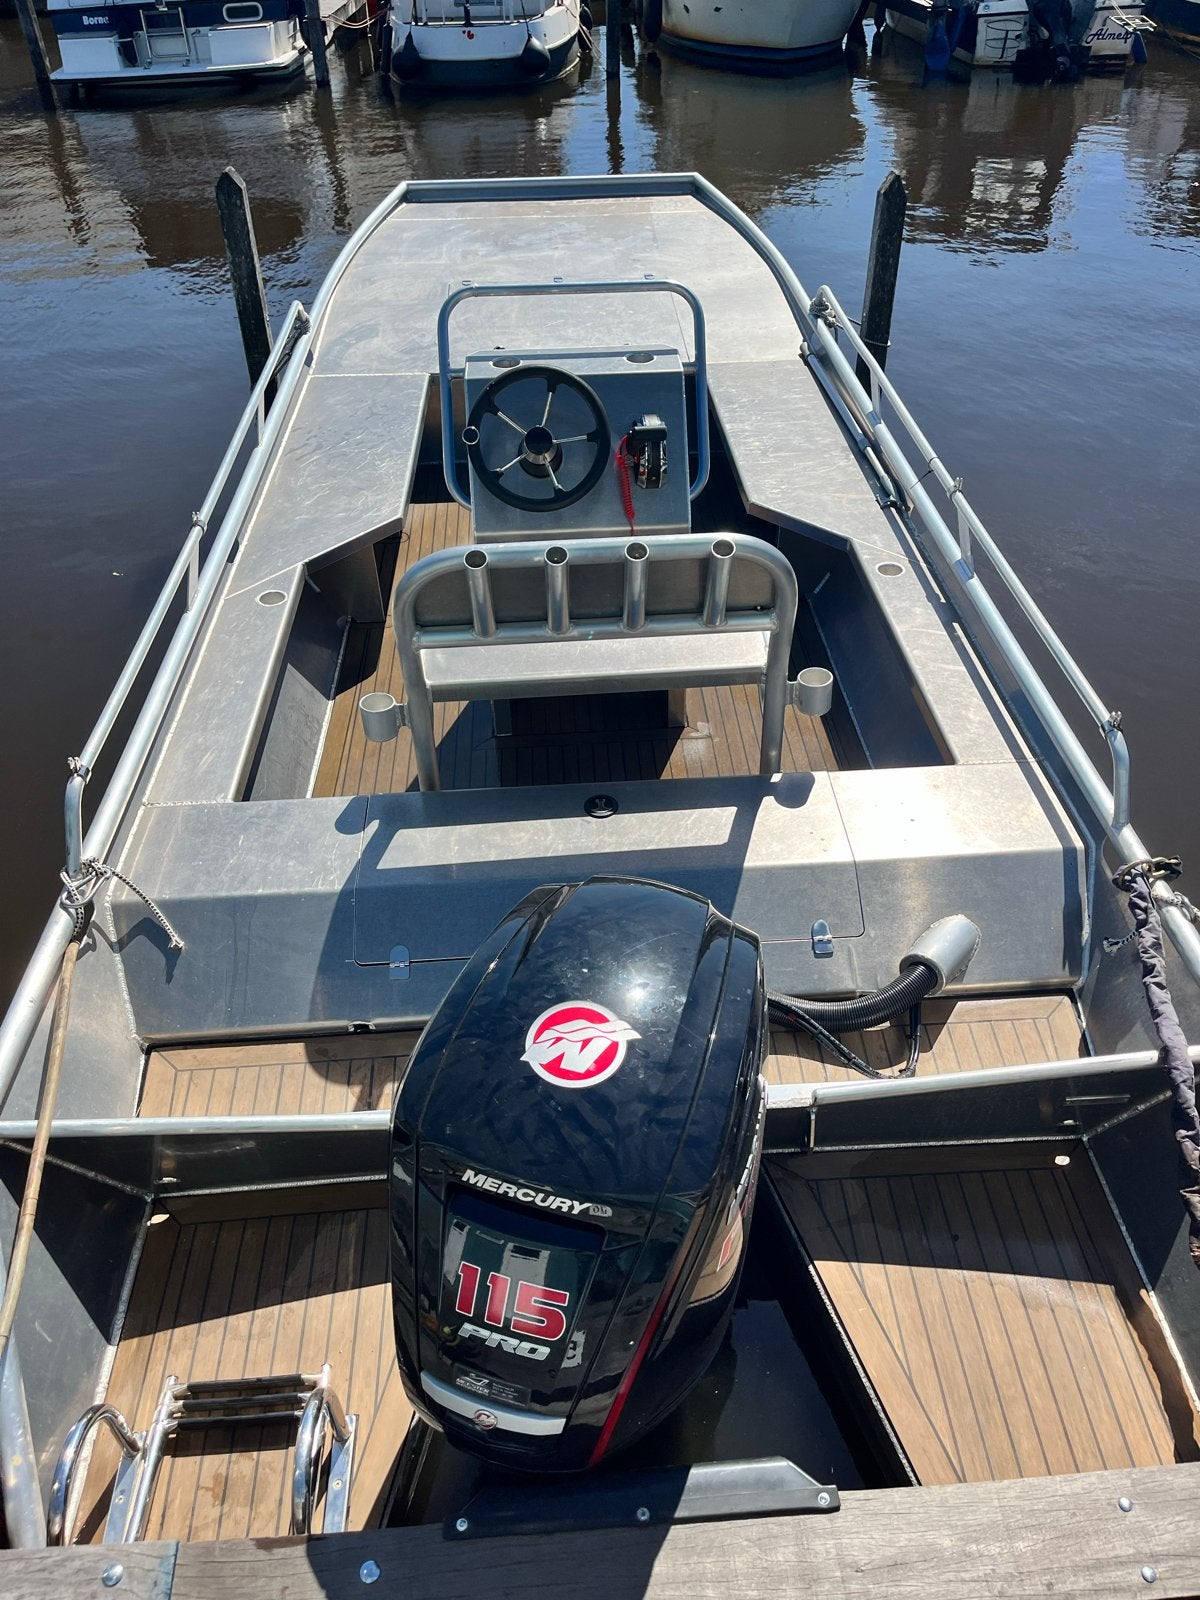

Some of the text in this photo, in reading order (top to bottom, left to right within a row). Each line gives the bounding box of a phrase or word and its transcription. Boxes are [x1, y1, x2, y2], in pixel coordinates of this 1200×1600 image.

[82, 16, 110, 25] Borne
[461, 1168, 593, 1215] MERCURY
[455, 1261, 569, 1340] 115
[458, 1322, 551, 1361] PRO
